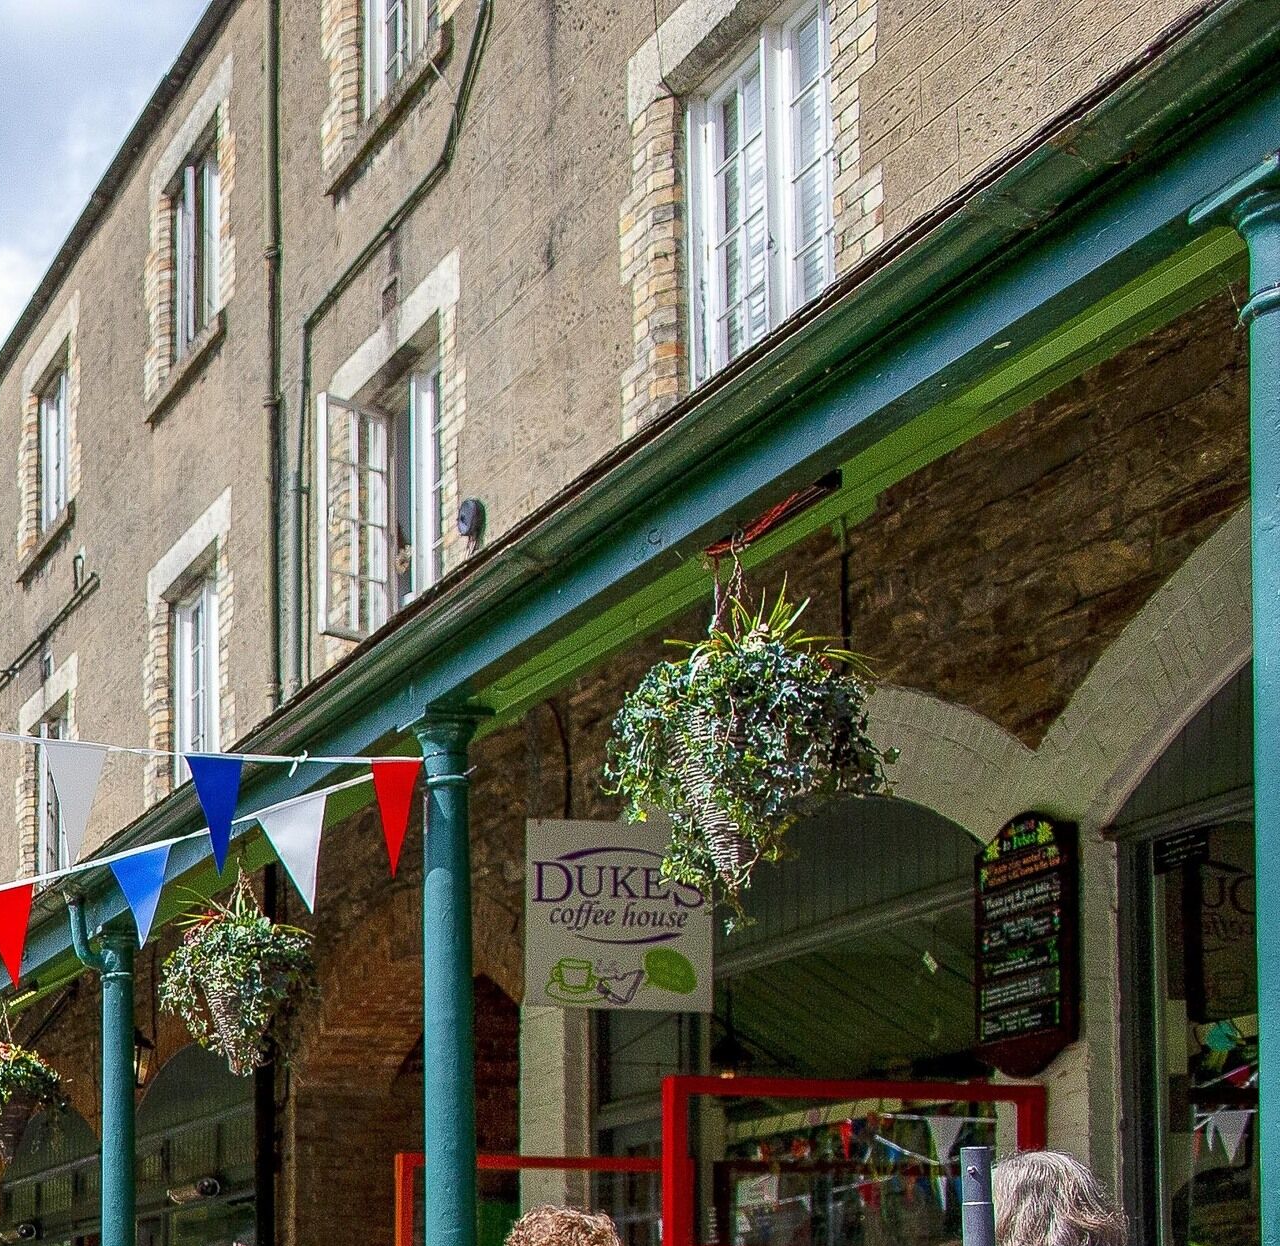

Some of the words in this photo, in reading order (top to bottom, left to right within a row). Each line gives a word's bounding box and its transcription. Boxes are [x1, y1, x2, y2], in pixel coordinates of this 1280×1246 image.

[532, 860, 705, 908] DUKES
[549, 901, 616, 931] coffee
[621, 901, 689, 929] house
